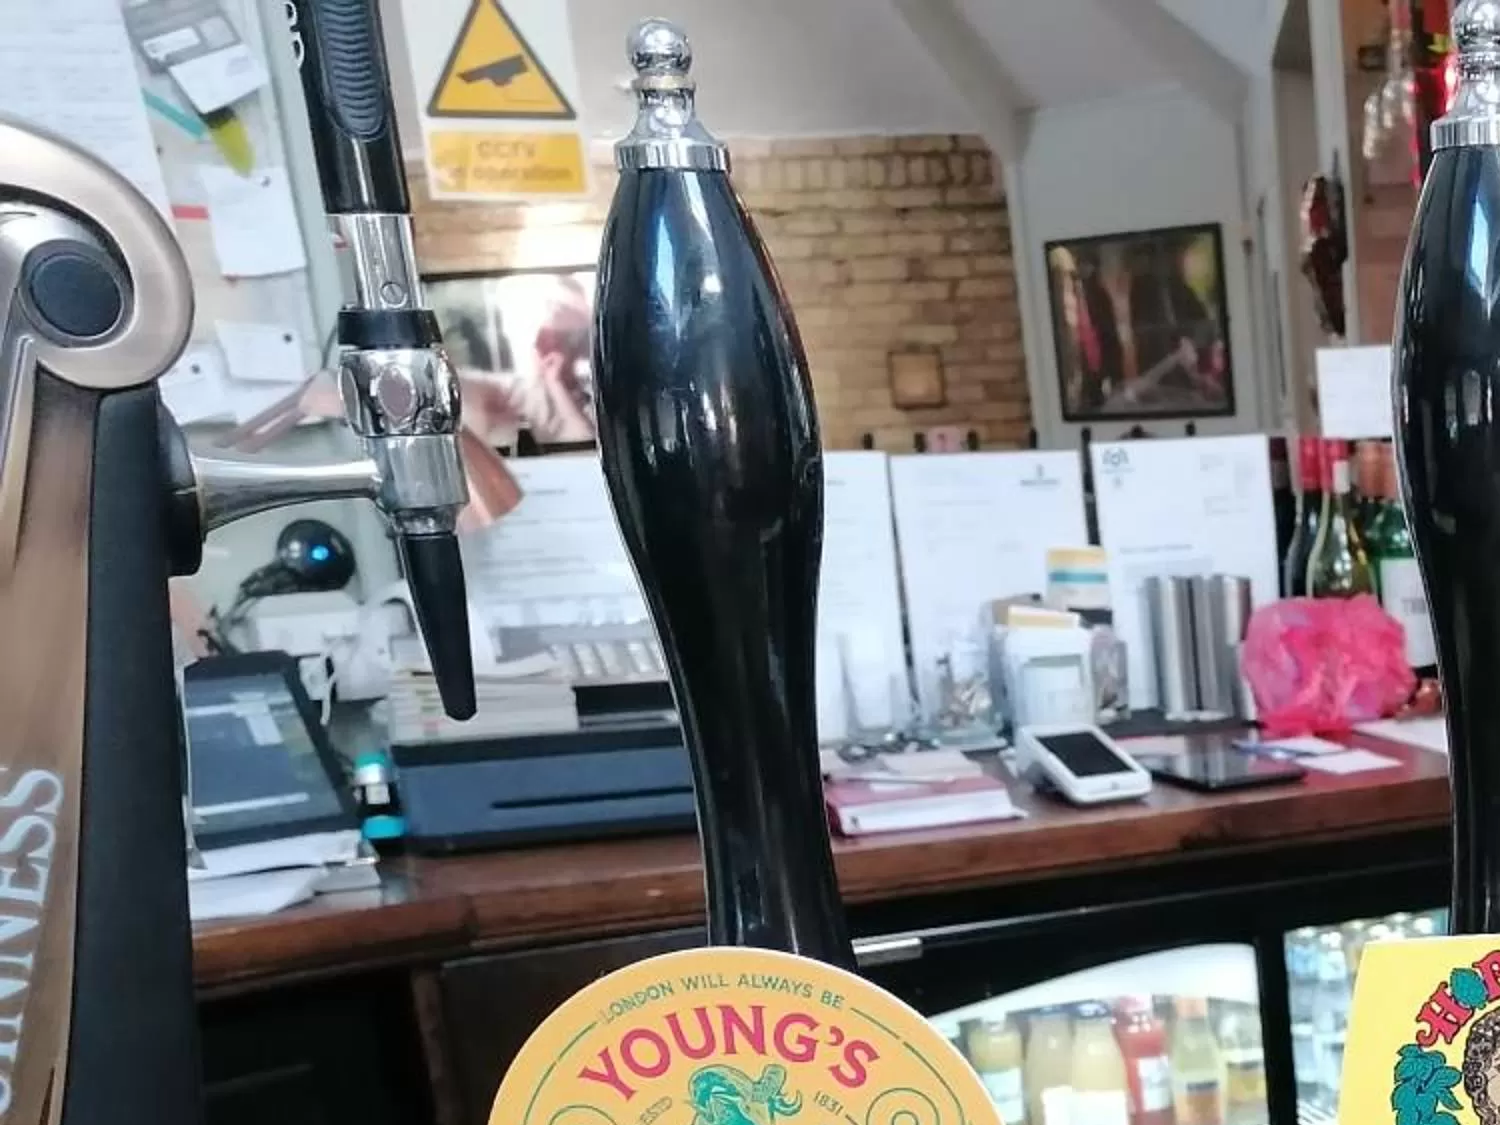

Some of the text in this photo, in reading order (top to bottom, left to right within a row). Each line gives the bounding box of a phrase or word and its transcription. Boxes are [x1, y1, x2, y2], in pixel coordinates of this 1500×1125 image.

[603, 973, 845, 1024] LONDON WILL ALWAYS BE
[577, 1004, 880, 1101] YOUNG'S
[813, 1091, 843, 1117] 1831
